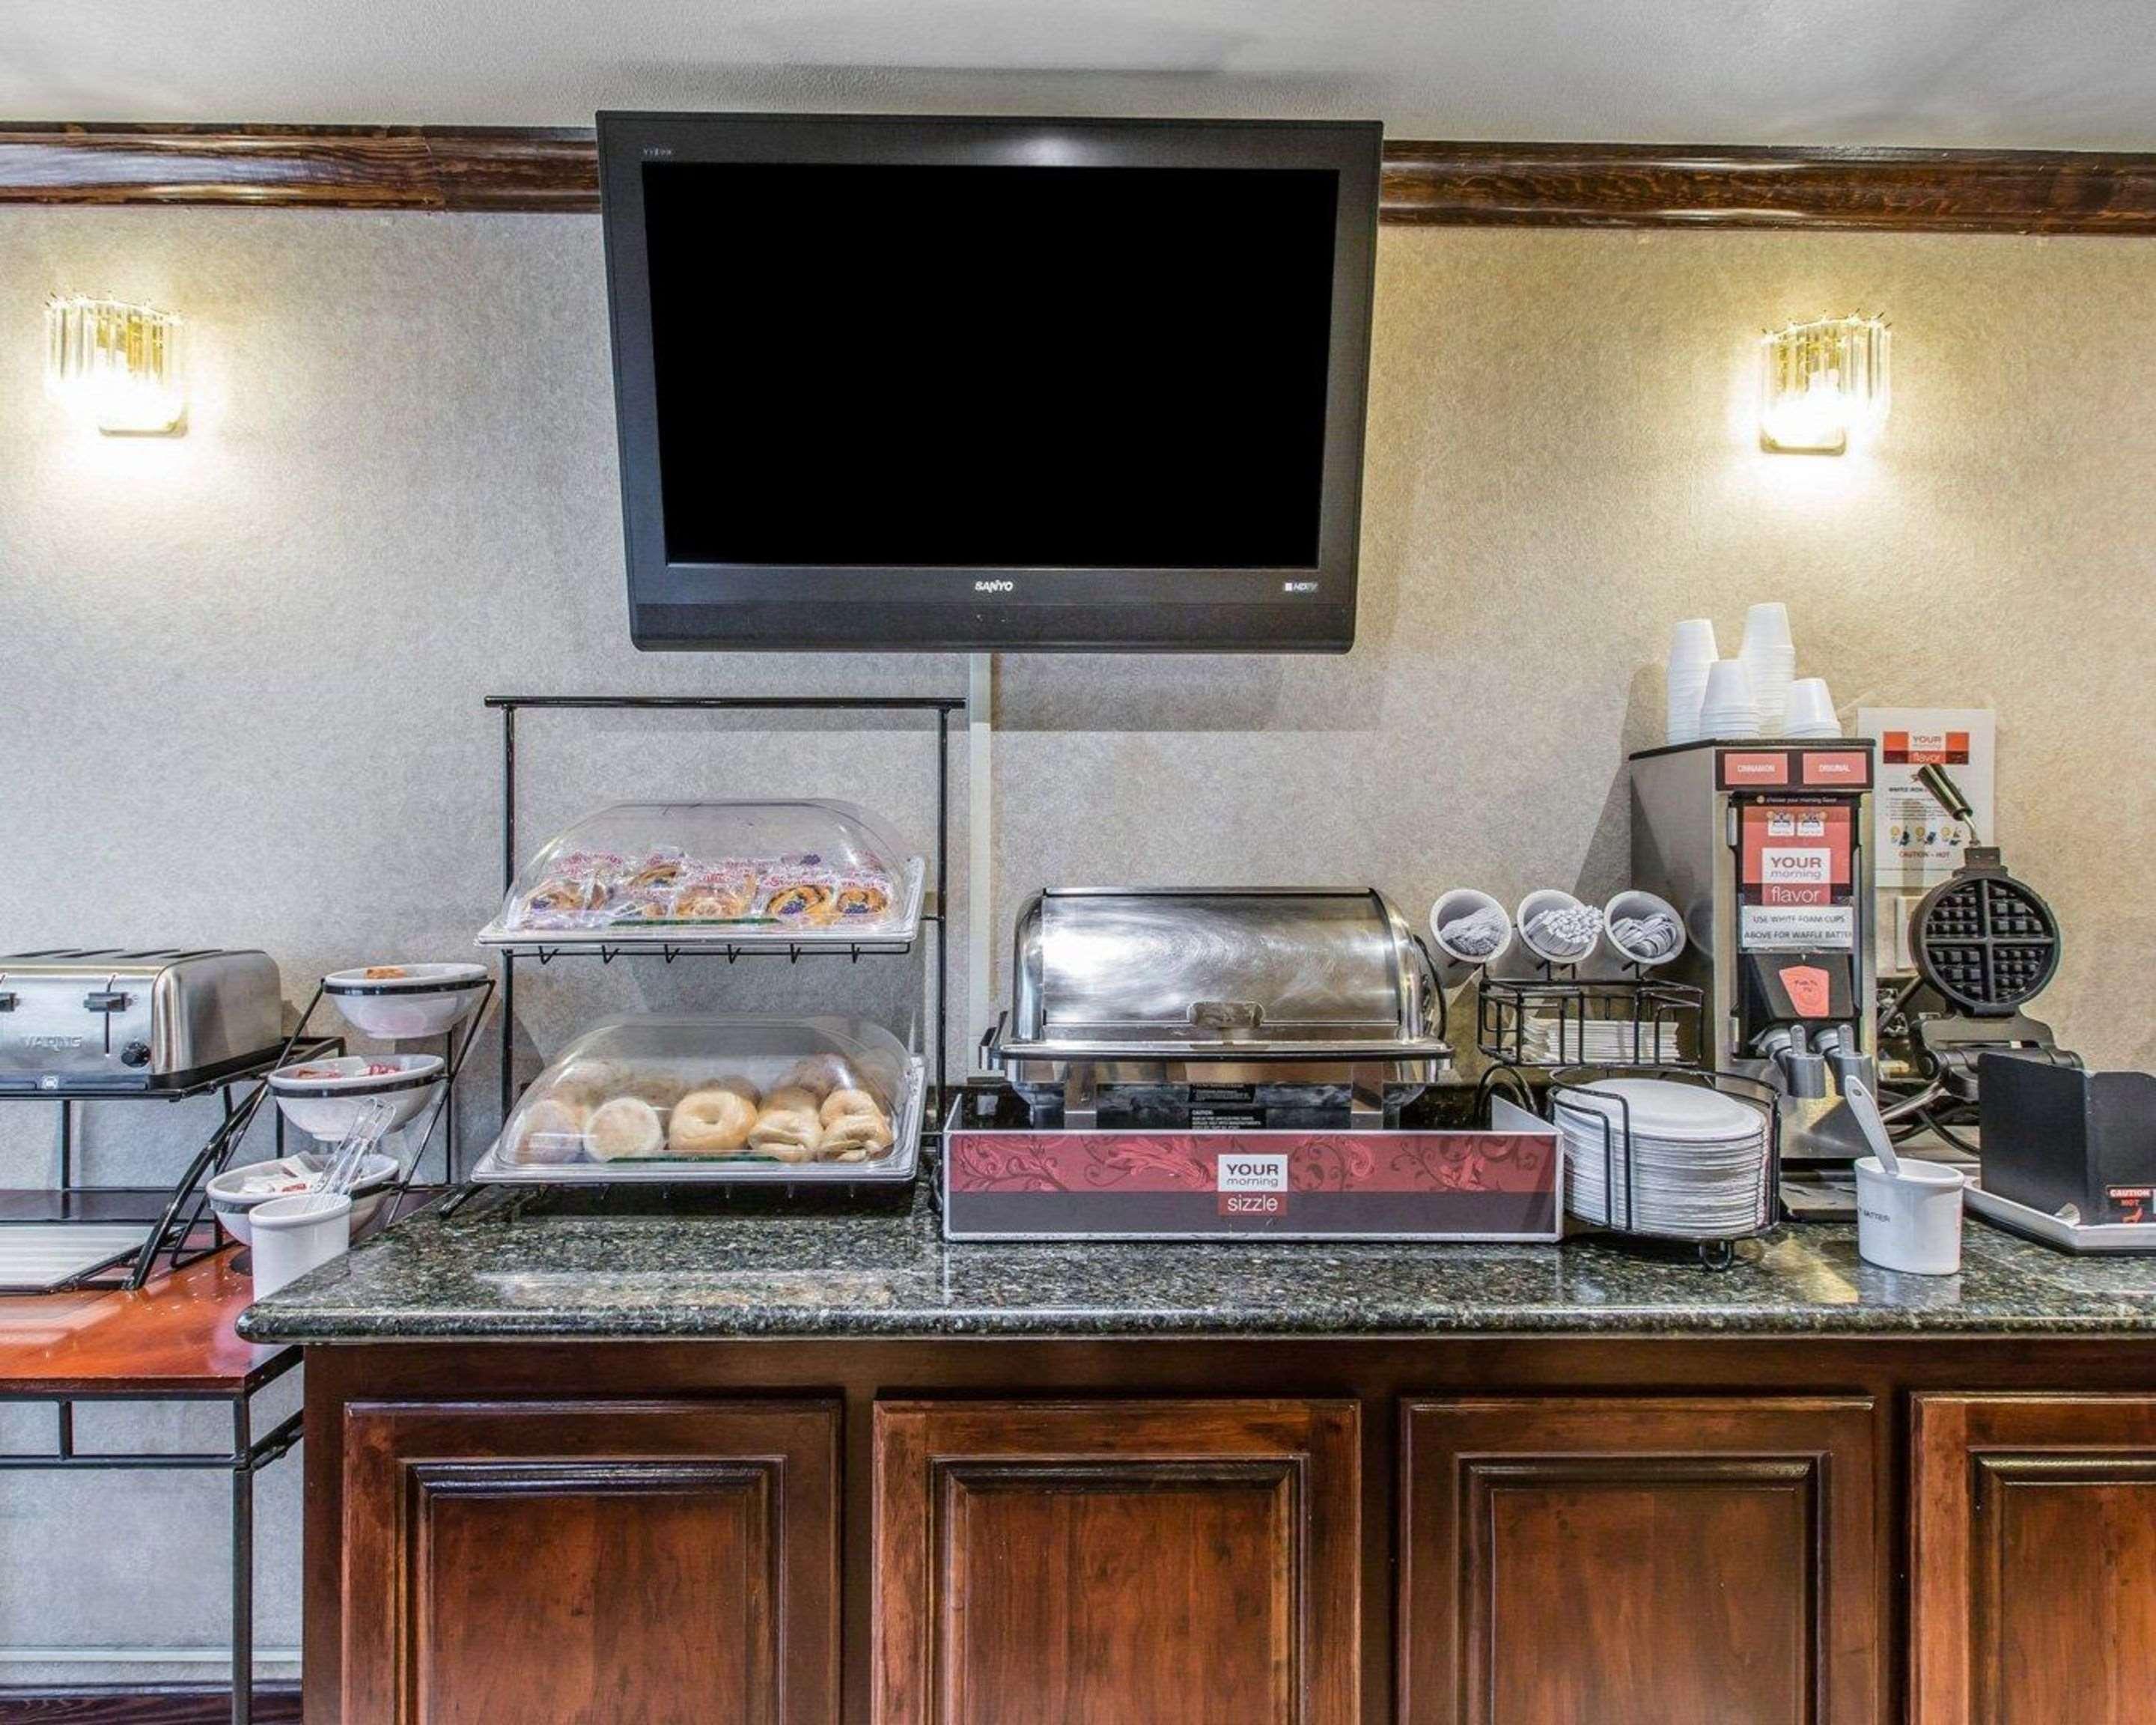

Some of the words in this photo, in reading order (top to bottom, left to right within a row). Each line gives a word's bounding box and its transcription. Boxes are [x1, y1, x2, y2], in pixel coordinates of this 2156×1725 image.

[975, 579, 1014, 593] SANYO
[1913, 735, 1942, 743] YOUR
[1737, 764, 1776, 773] CINNAMON
[1818, 764, 1851, 773] ORIGINAL
[1771, 857, 1821, 868] YOUR
[1771, 869, 1821, 879] morning
[1771, 886, 1821, 903] flavor
[1226, 1163, 1279, 1175] YOUR
[1226, 1177, 1279, 1187] morning
[2110, 1189, 2150, 1197] CAUTION
[1227, 1195, 1279, 1211] sizzle
